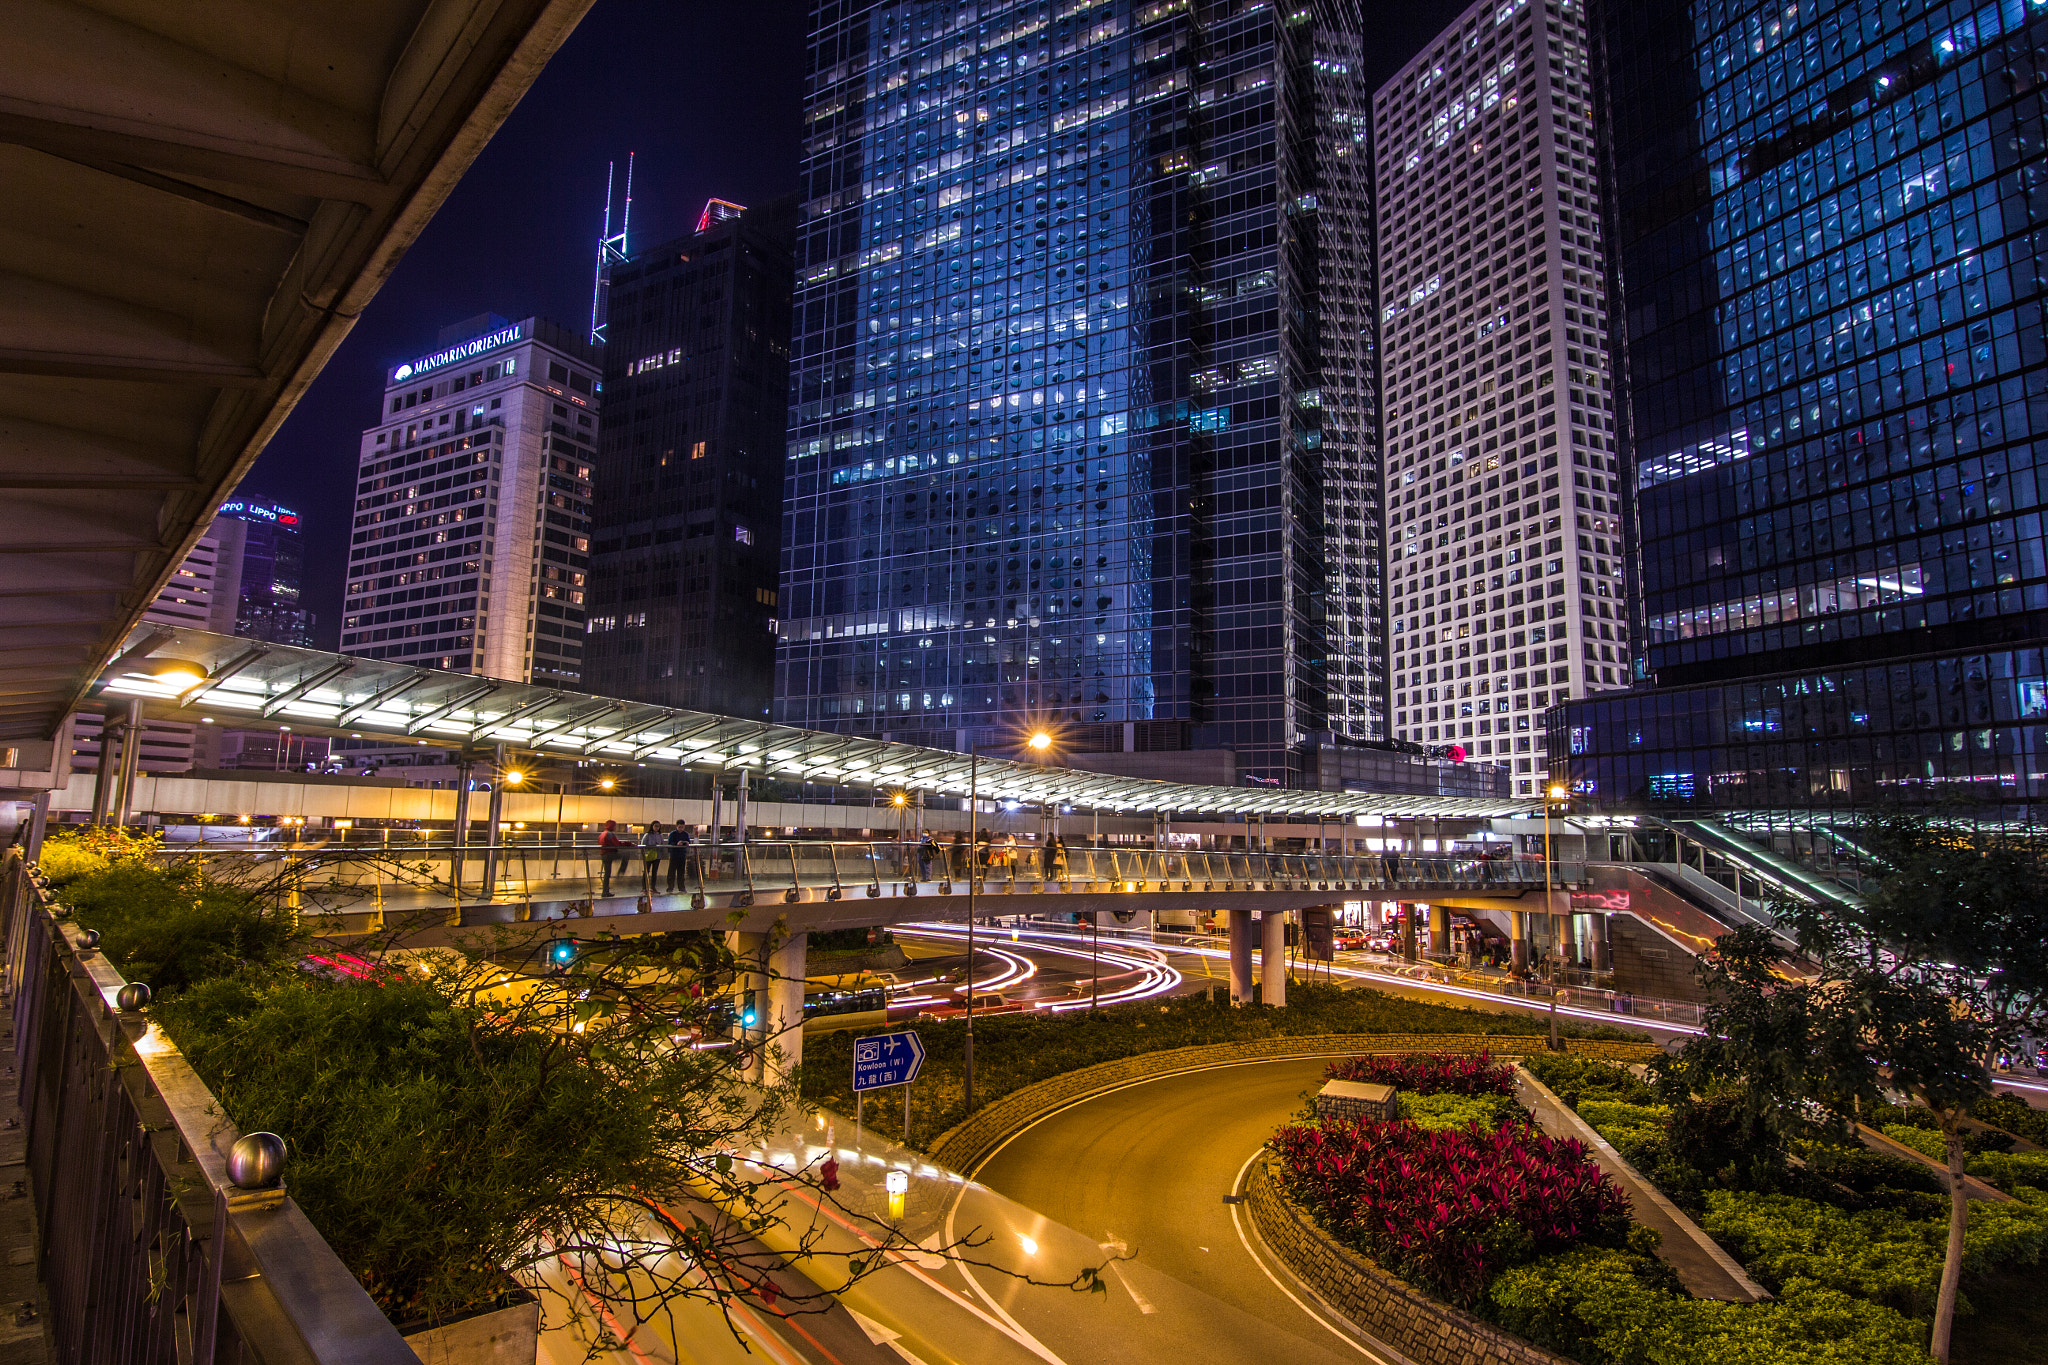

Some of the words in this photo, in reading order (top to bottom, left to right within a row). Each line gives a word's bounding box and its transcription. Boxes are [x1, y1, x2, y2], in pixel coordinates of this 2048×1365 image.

[413, 344, 467, 374] MANDARIN
[468, 325, 520, 355] ORIENTAL
[219, 502, 243, 511] IPPO
[249, 504, 276, 520] LIPPO
[858, 1062, 886, 1072] Kowloon
